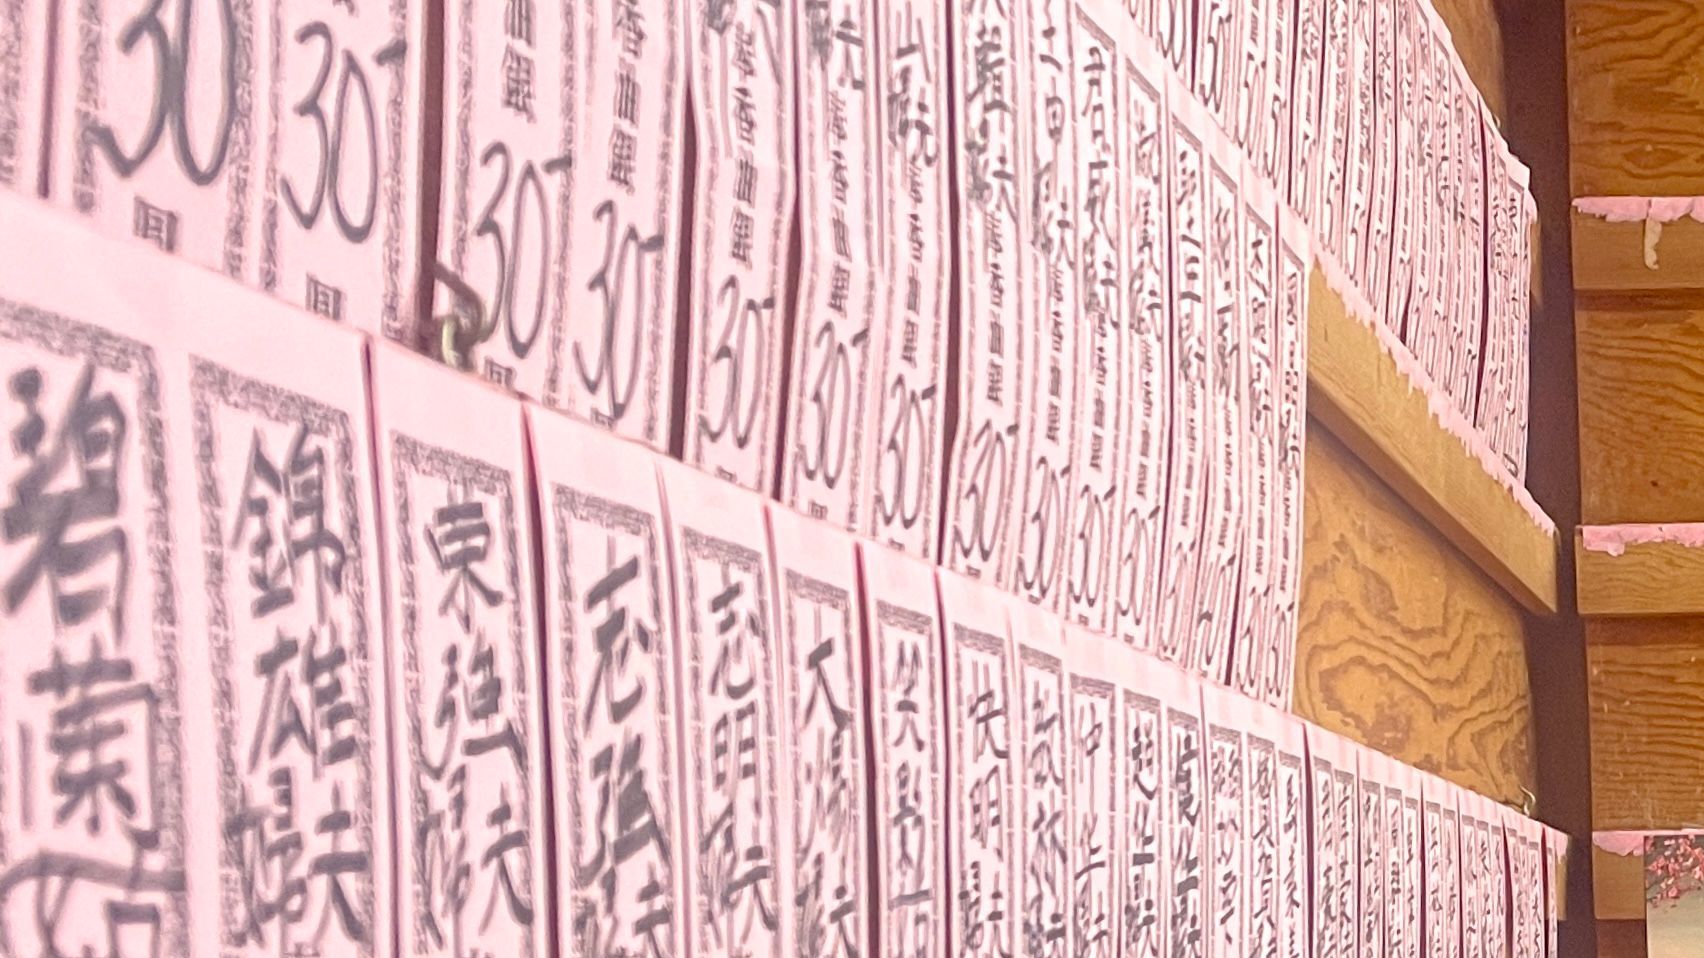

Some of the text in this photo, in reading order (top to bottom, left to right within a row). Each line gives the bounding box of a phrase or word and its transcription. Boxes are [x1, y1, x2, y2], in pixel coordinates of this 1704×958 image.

[281, 20, 378, 244] 30
[573, 198, 645, 419] 30
[698, 273, 767, 449] 30
